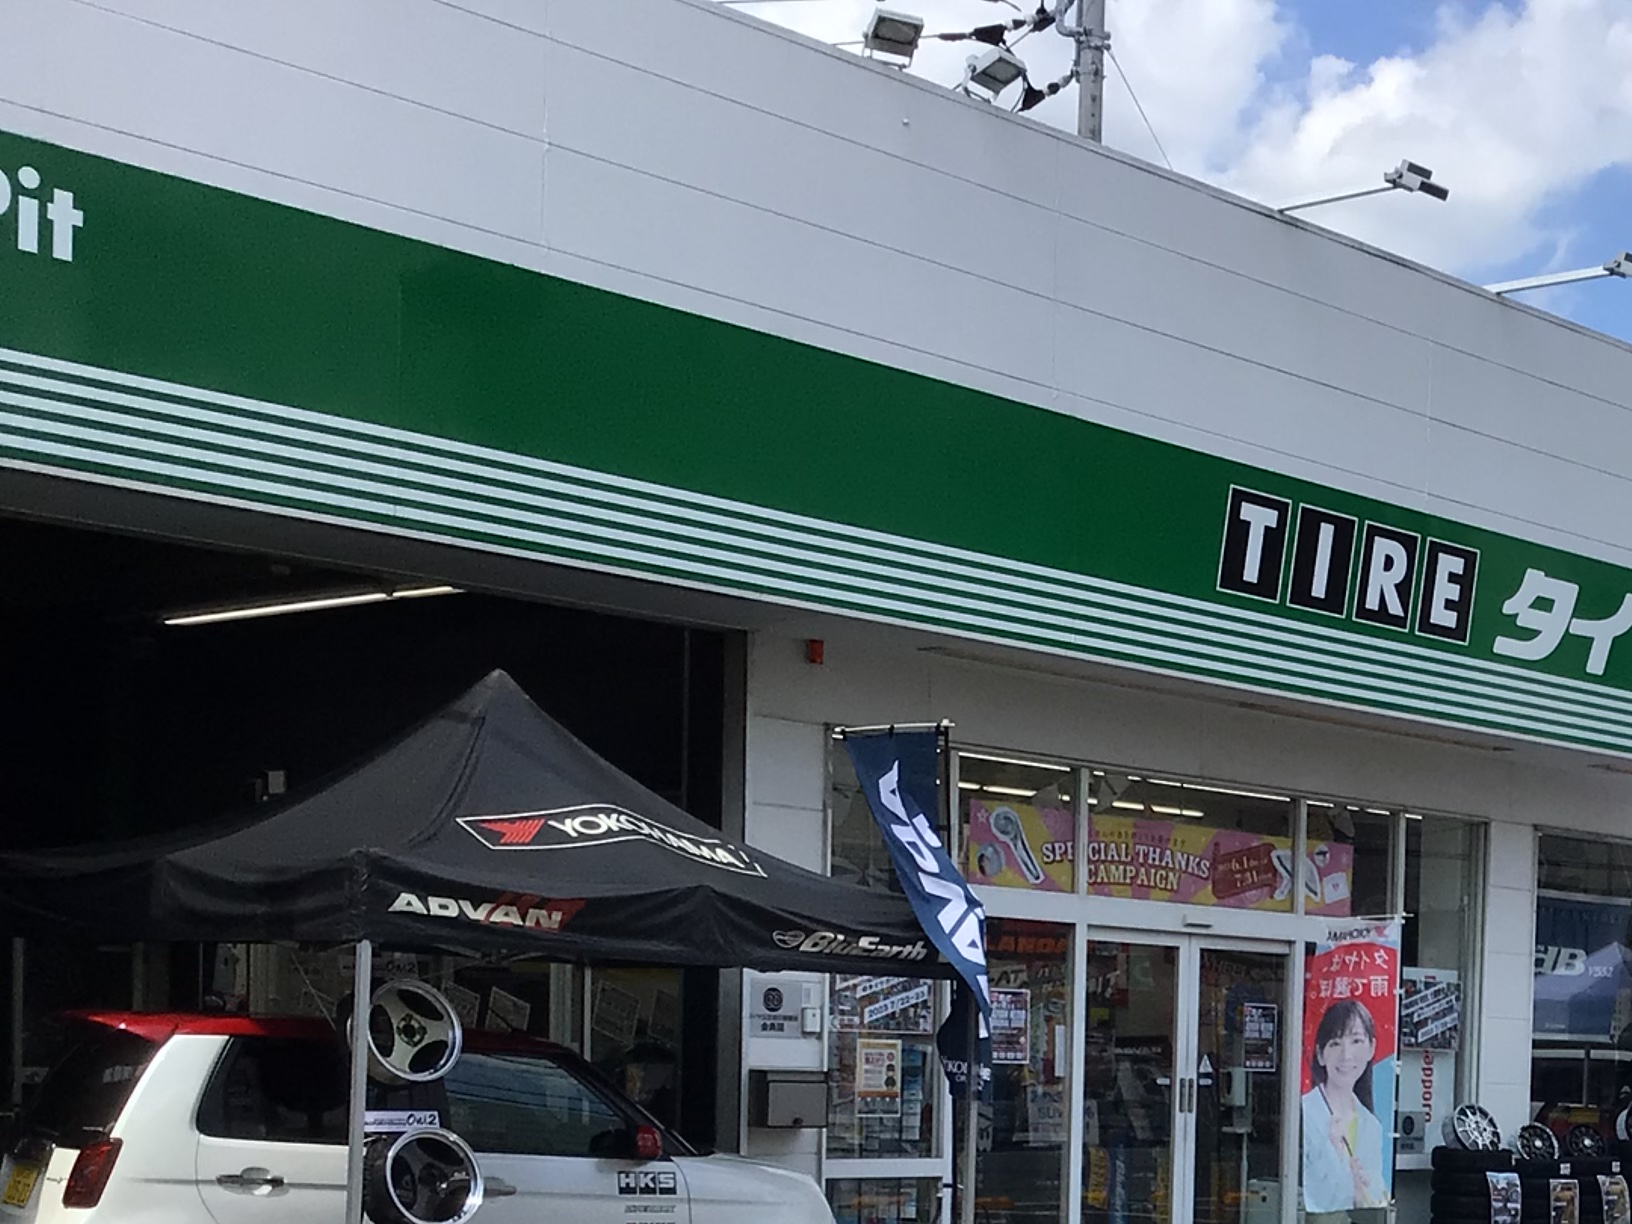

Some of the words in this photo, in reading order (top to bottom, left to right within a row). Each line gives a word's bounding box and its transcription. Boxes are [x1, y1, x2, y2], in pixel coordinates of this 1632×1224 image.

[1234, 497, 1468, 632] TIRE
[547, 813, 746, 868] YOKOHAMA
[1088, 864, 1180, 890] CAMPAIGN
[1135, 844, 1210, 878] THANKS
[387, 892, 562, 930] ADVAN
[619, 1172, 676, 1191] HKS
